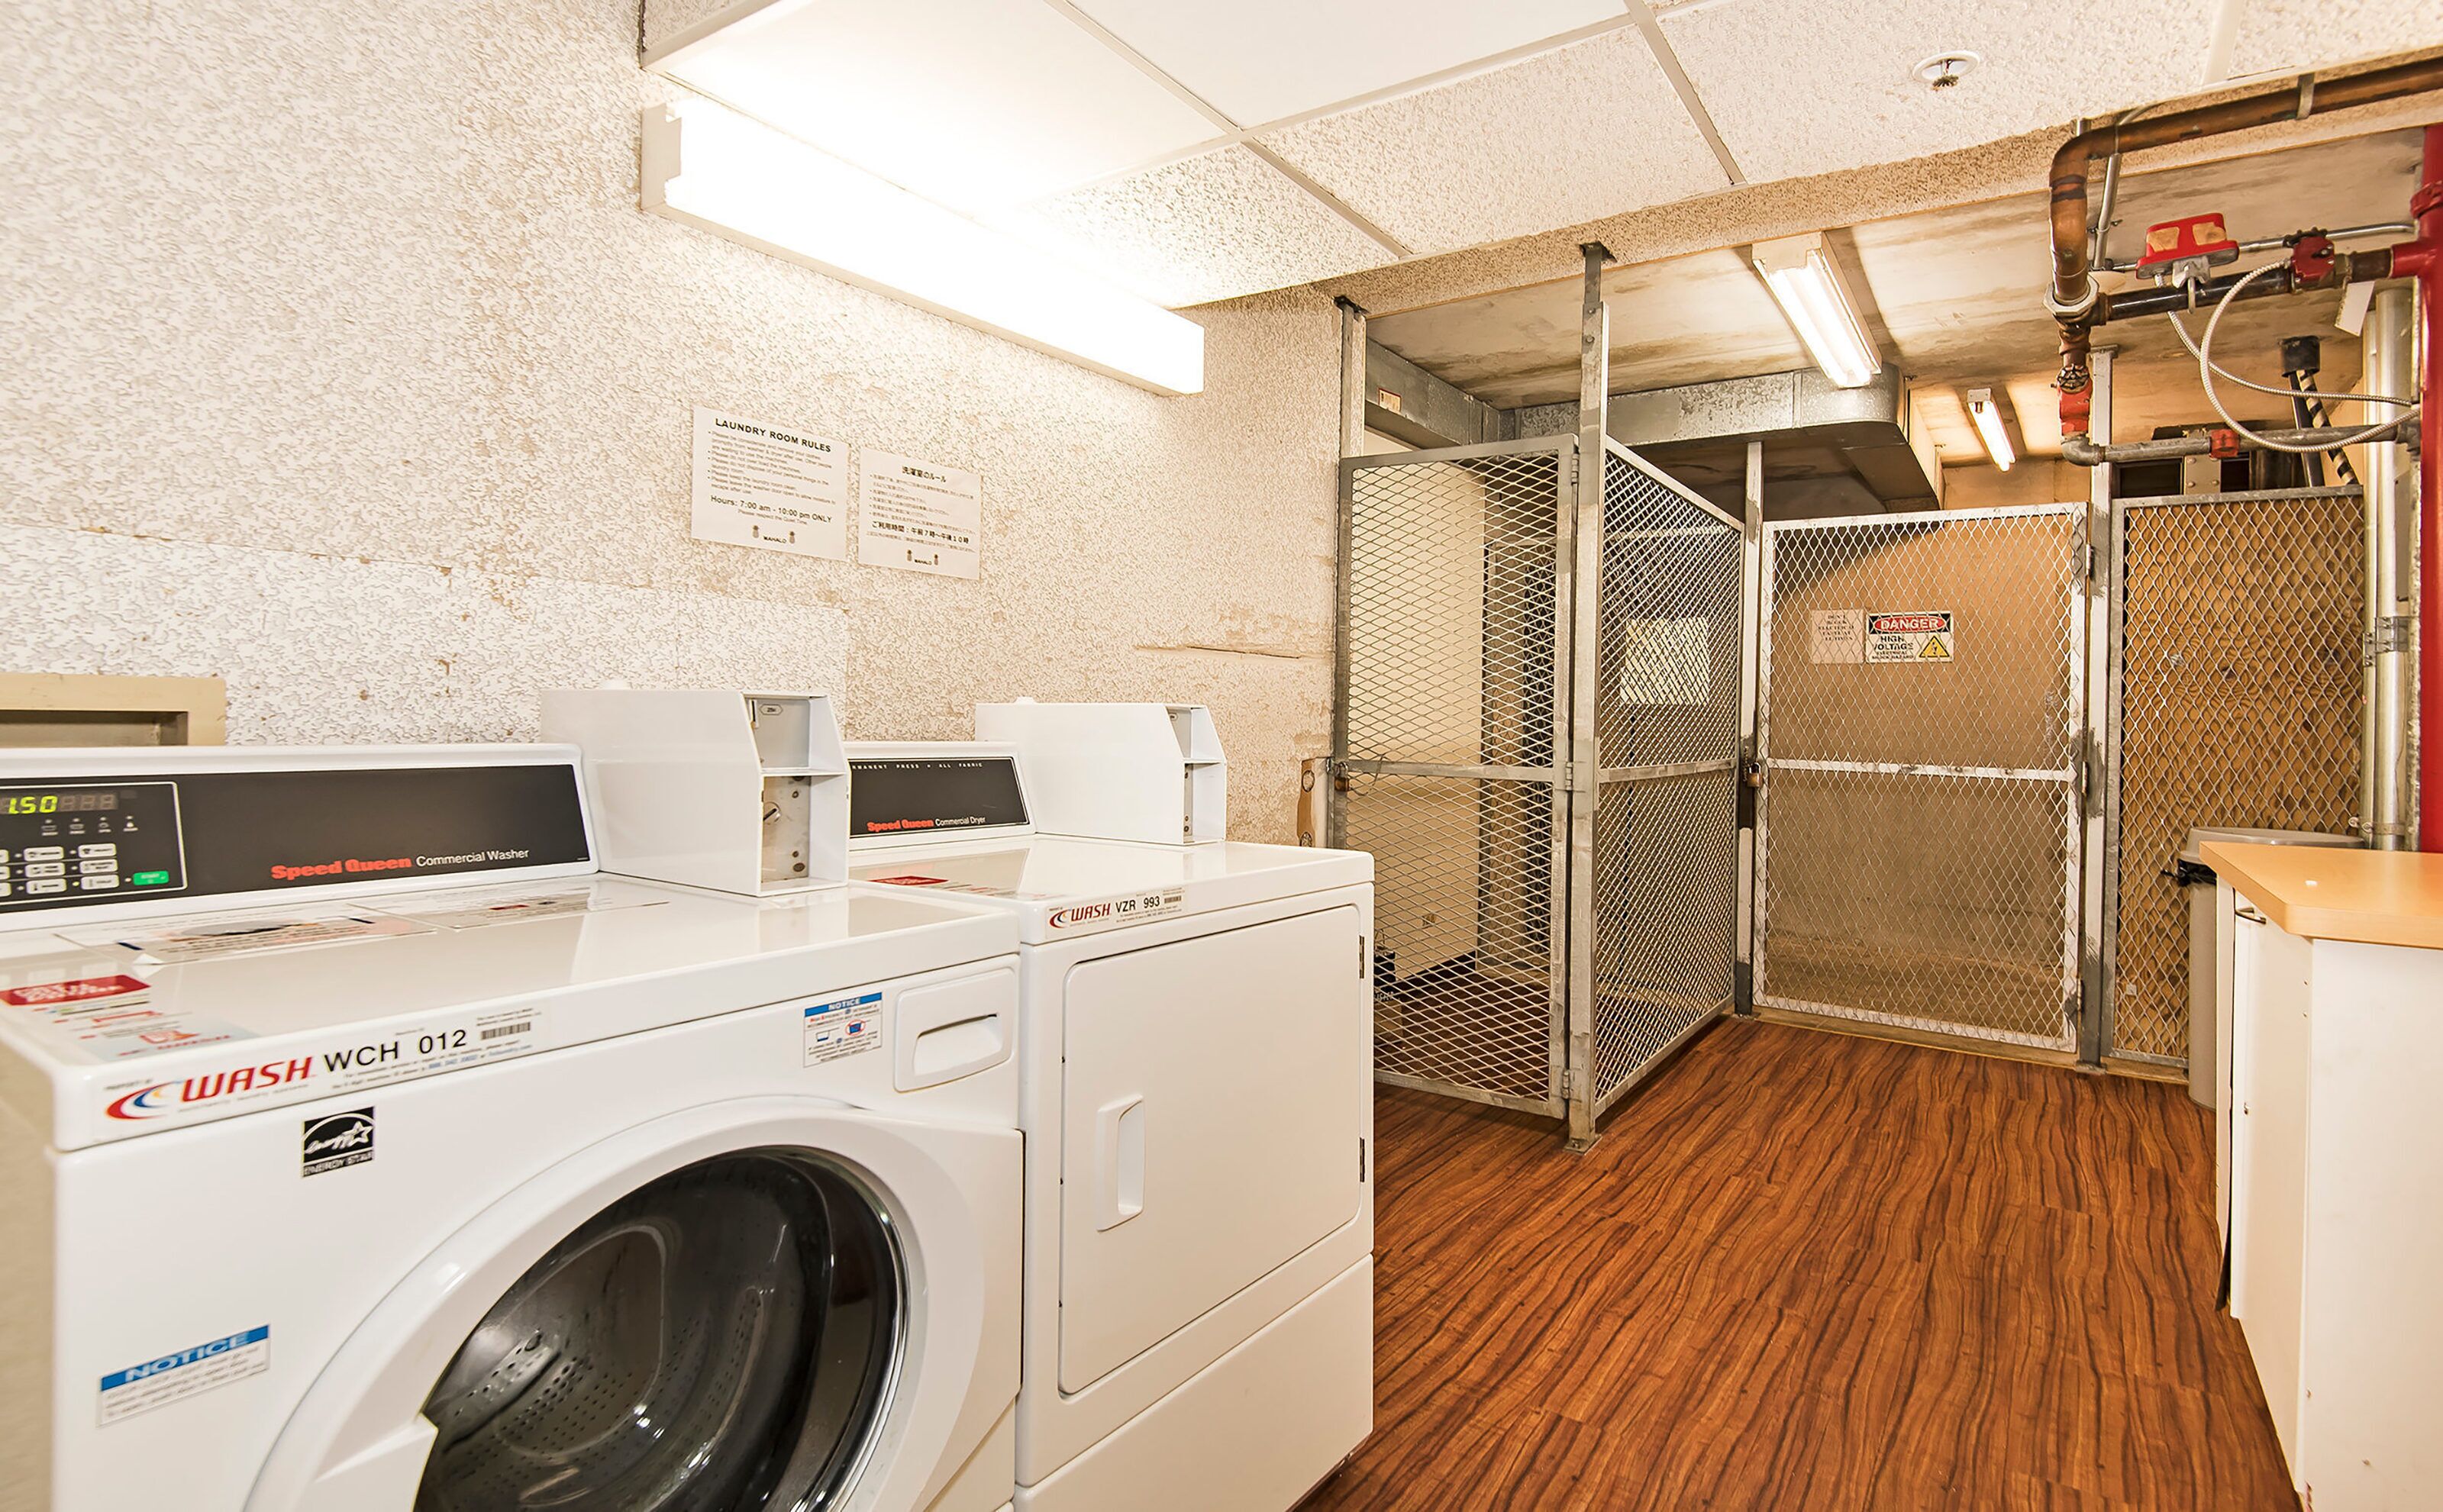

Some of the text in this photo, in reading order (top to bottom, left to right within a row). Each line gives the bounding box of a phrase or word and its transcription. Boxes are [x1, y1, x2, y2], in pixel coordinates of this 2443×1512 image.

[715, 417, 831, 453] LAUNDRY ROOM RULES
[712, 495, 737, 506] Hours:
[741, 500, 757, 510] 7:00
[760, 504, 771, 512] am
[779, 508, 797, 517] 10:00
[799, 511, 810, 521] pm
[812, 514, 832, 524] ONLY
[1880, 619, 1939, 630] DANGER
[867, 816, 986, 833] Speed Queen Commercial Dryer
[271, 849, 530, 881] Speed Queen Commercial Washer
[1070, 902, 1112, 922] WASH
[1115, 899, 1136, 913] VZR
[1144, 895, 1160, 909] 993
[828, 997, 861, 1011] NOTICE
[180, 1056, 313, 1103] WASH
[323, 1040, 399, 1072] WCH
[418, 1029, 467, 1054] 012
[124, 1330, 250, 1382] NOTICE
